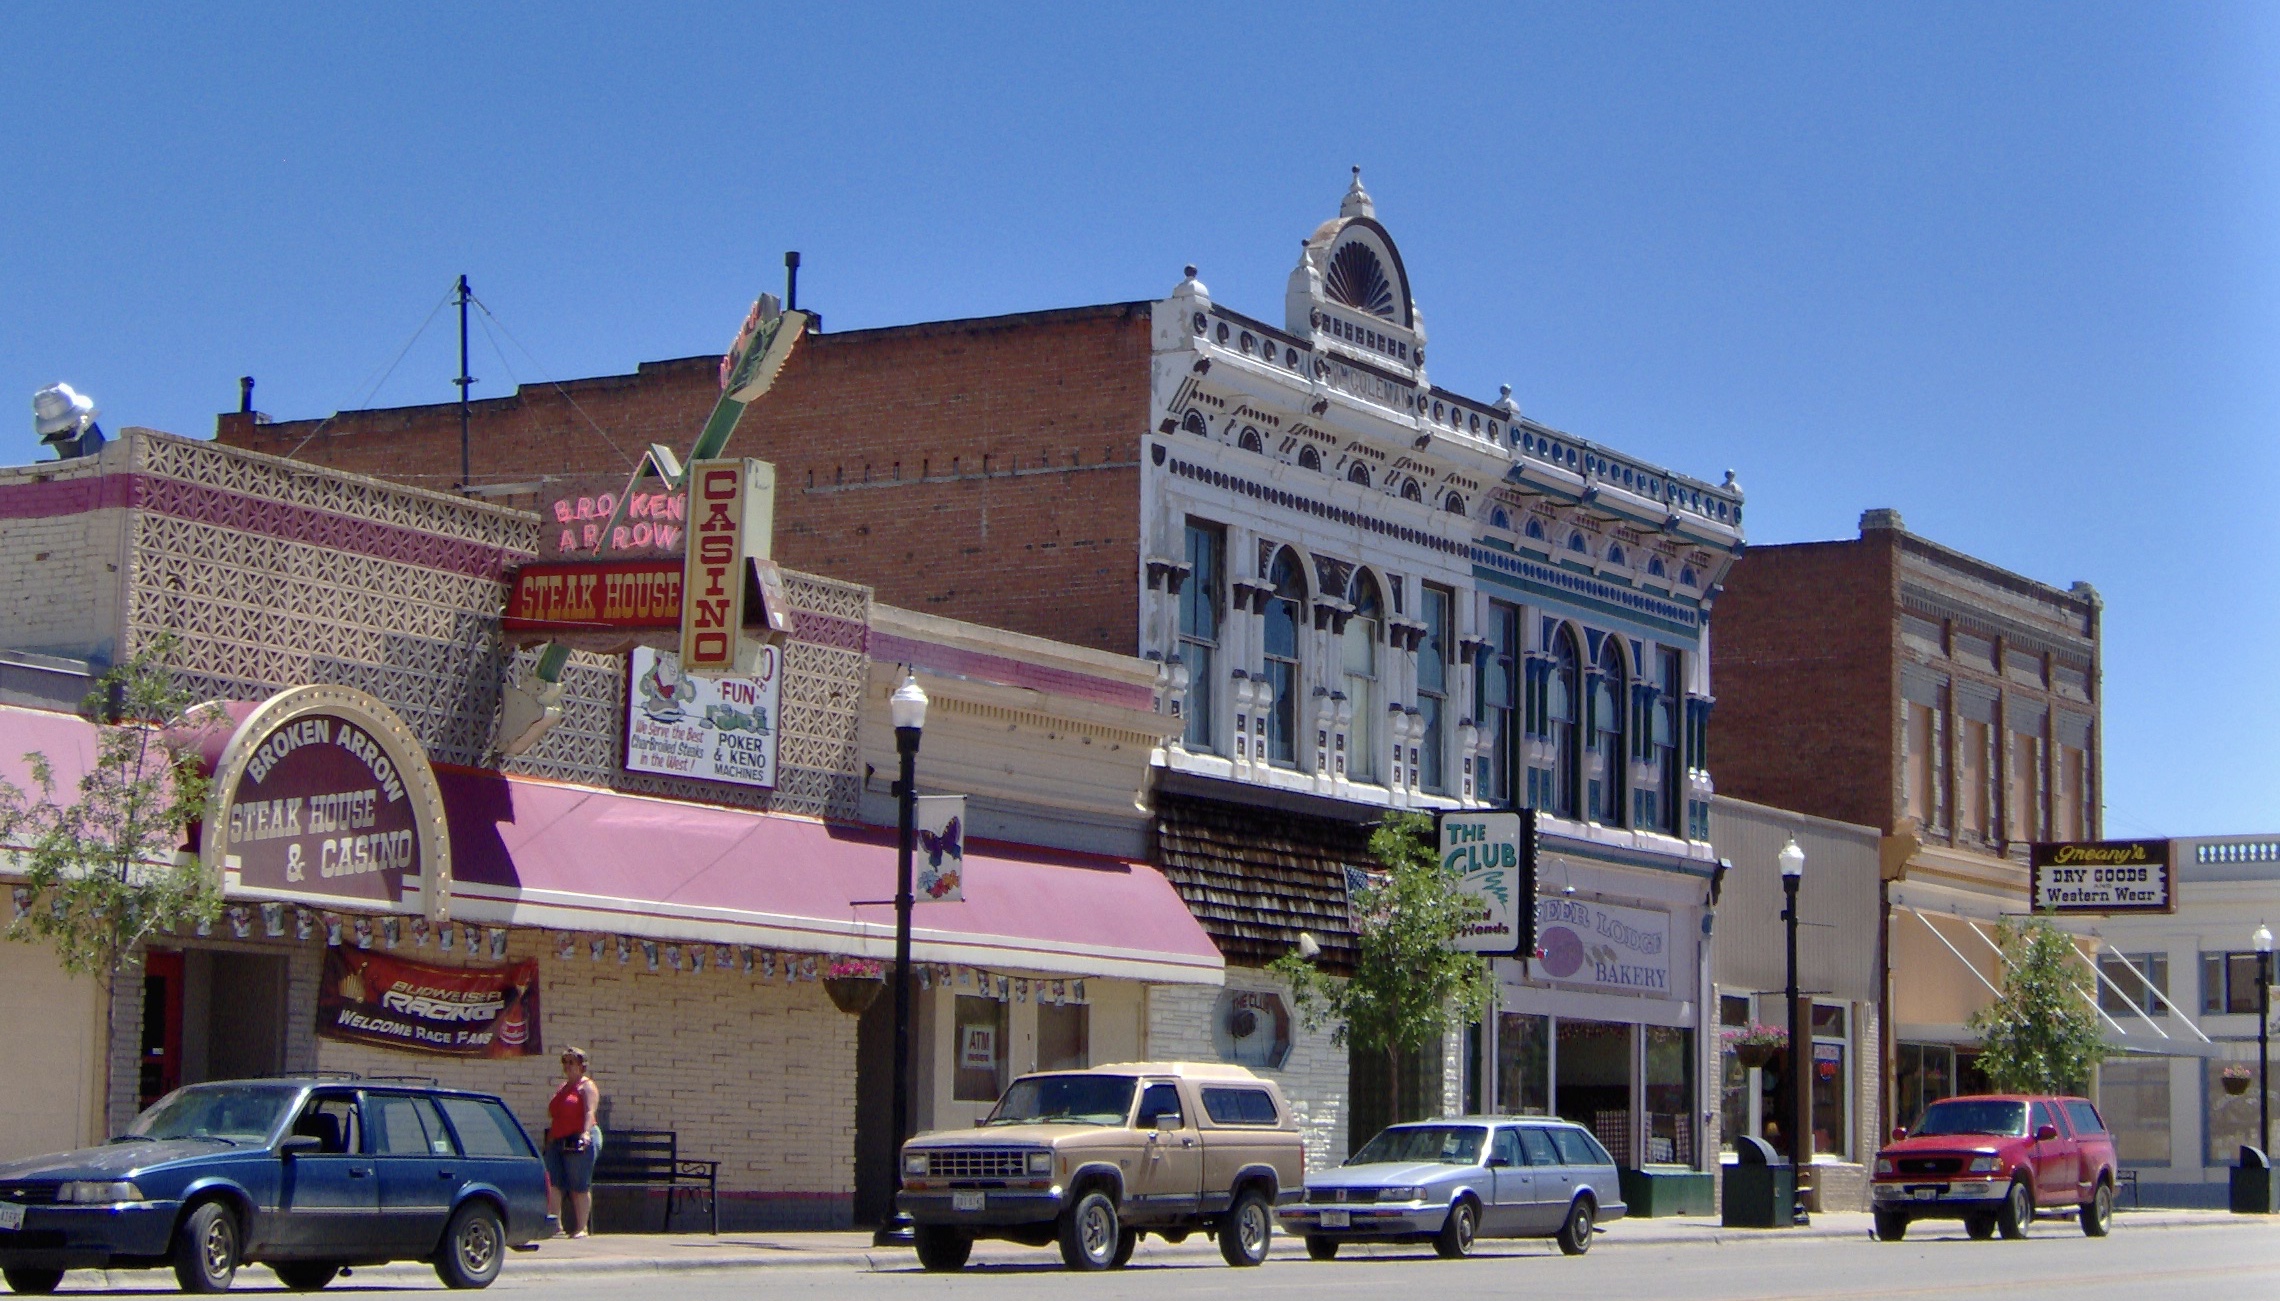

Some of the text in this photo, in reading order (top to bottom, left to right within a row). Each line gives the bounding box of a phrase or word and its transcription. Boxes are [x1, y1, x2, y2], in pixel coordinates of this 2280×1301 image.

[694, 470, 737, 662] CASINO
[521, 571, 680, 619] STEAK HOUSE
[721, 681, 755, 705] FUN
[649, 722, 670, 739] Serve
[672, 724, 685, 739] the
[686, 727, 705, 743] Best
[719, 733, 763, 752] POKER
[247, 719, 404, 803] BROKEN ARROW
[639, 750, 648, 766] in
[651, 752, 664, 768] the
[678, 741, 704, 759] Steaks
[714, 748, 766, 768] & KENO
[715, 763, 764, 781] MACHINES
[230, 789, 377, 843] STEAK HOUSE
[1446, 824, 1486, 845] THE
[286, 829, 412, 882] & CASINO
[1444, 843, 1517, 875] CLUB
[2053, 868, 2147, 883] DRY GOODS
[2047, 887, 2155, 902] Western Wear
[1597, 912, 1662, 955] LODGE
[1595, 961, 1667, 988] BAKERY
[383, 991, 505, 1021] RACING
[969, 1031, 990, 1050] ATM
